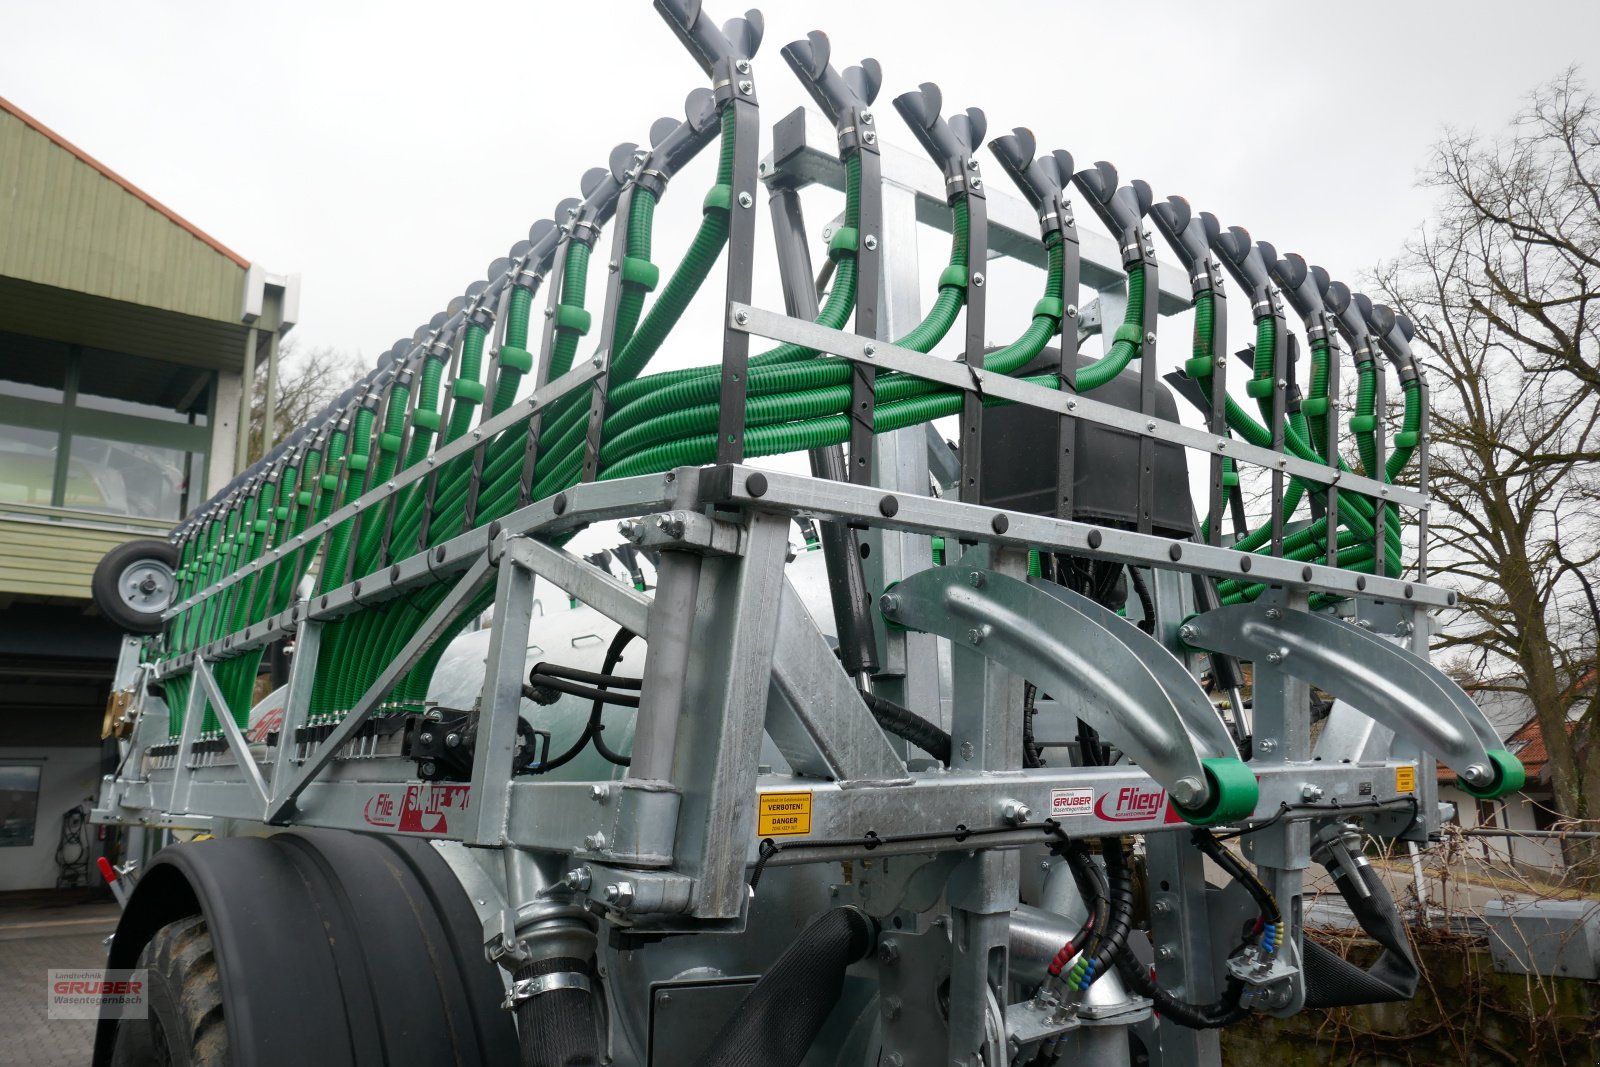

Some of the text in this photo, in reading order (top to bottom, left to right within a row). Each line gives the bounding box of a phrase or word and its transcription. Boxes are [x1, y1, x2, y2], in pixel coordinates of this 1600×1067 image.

[408, 785, 447, 813] SKATE
[1053, 797, 1091, 806] GRUBER
[1116, 787, 1166, 815] Fliegl
[768, 803, 803, 811] VERBOTEN!
[772, 817, 798, 825] DANGER
